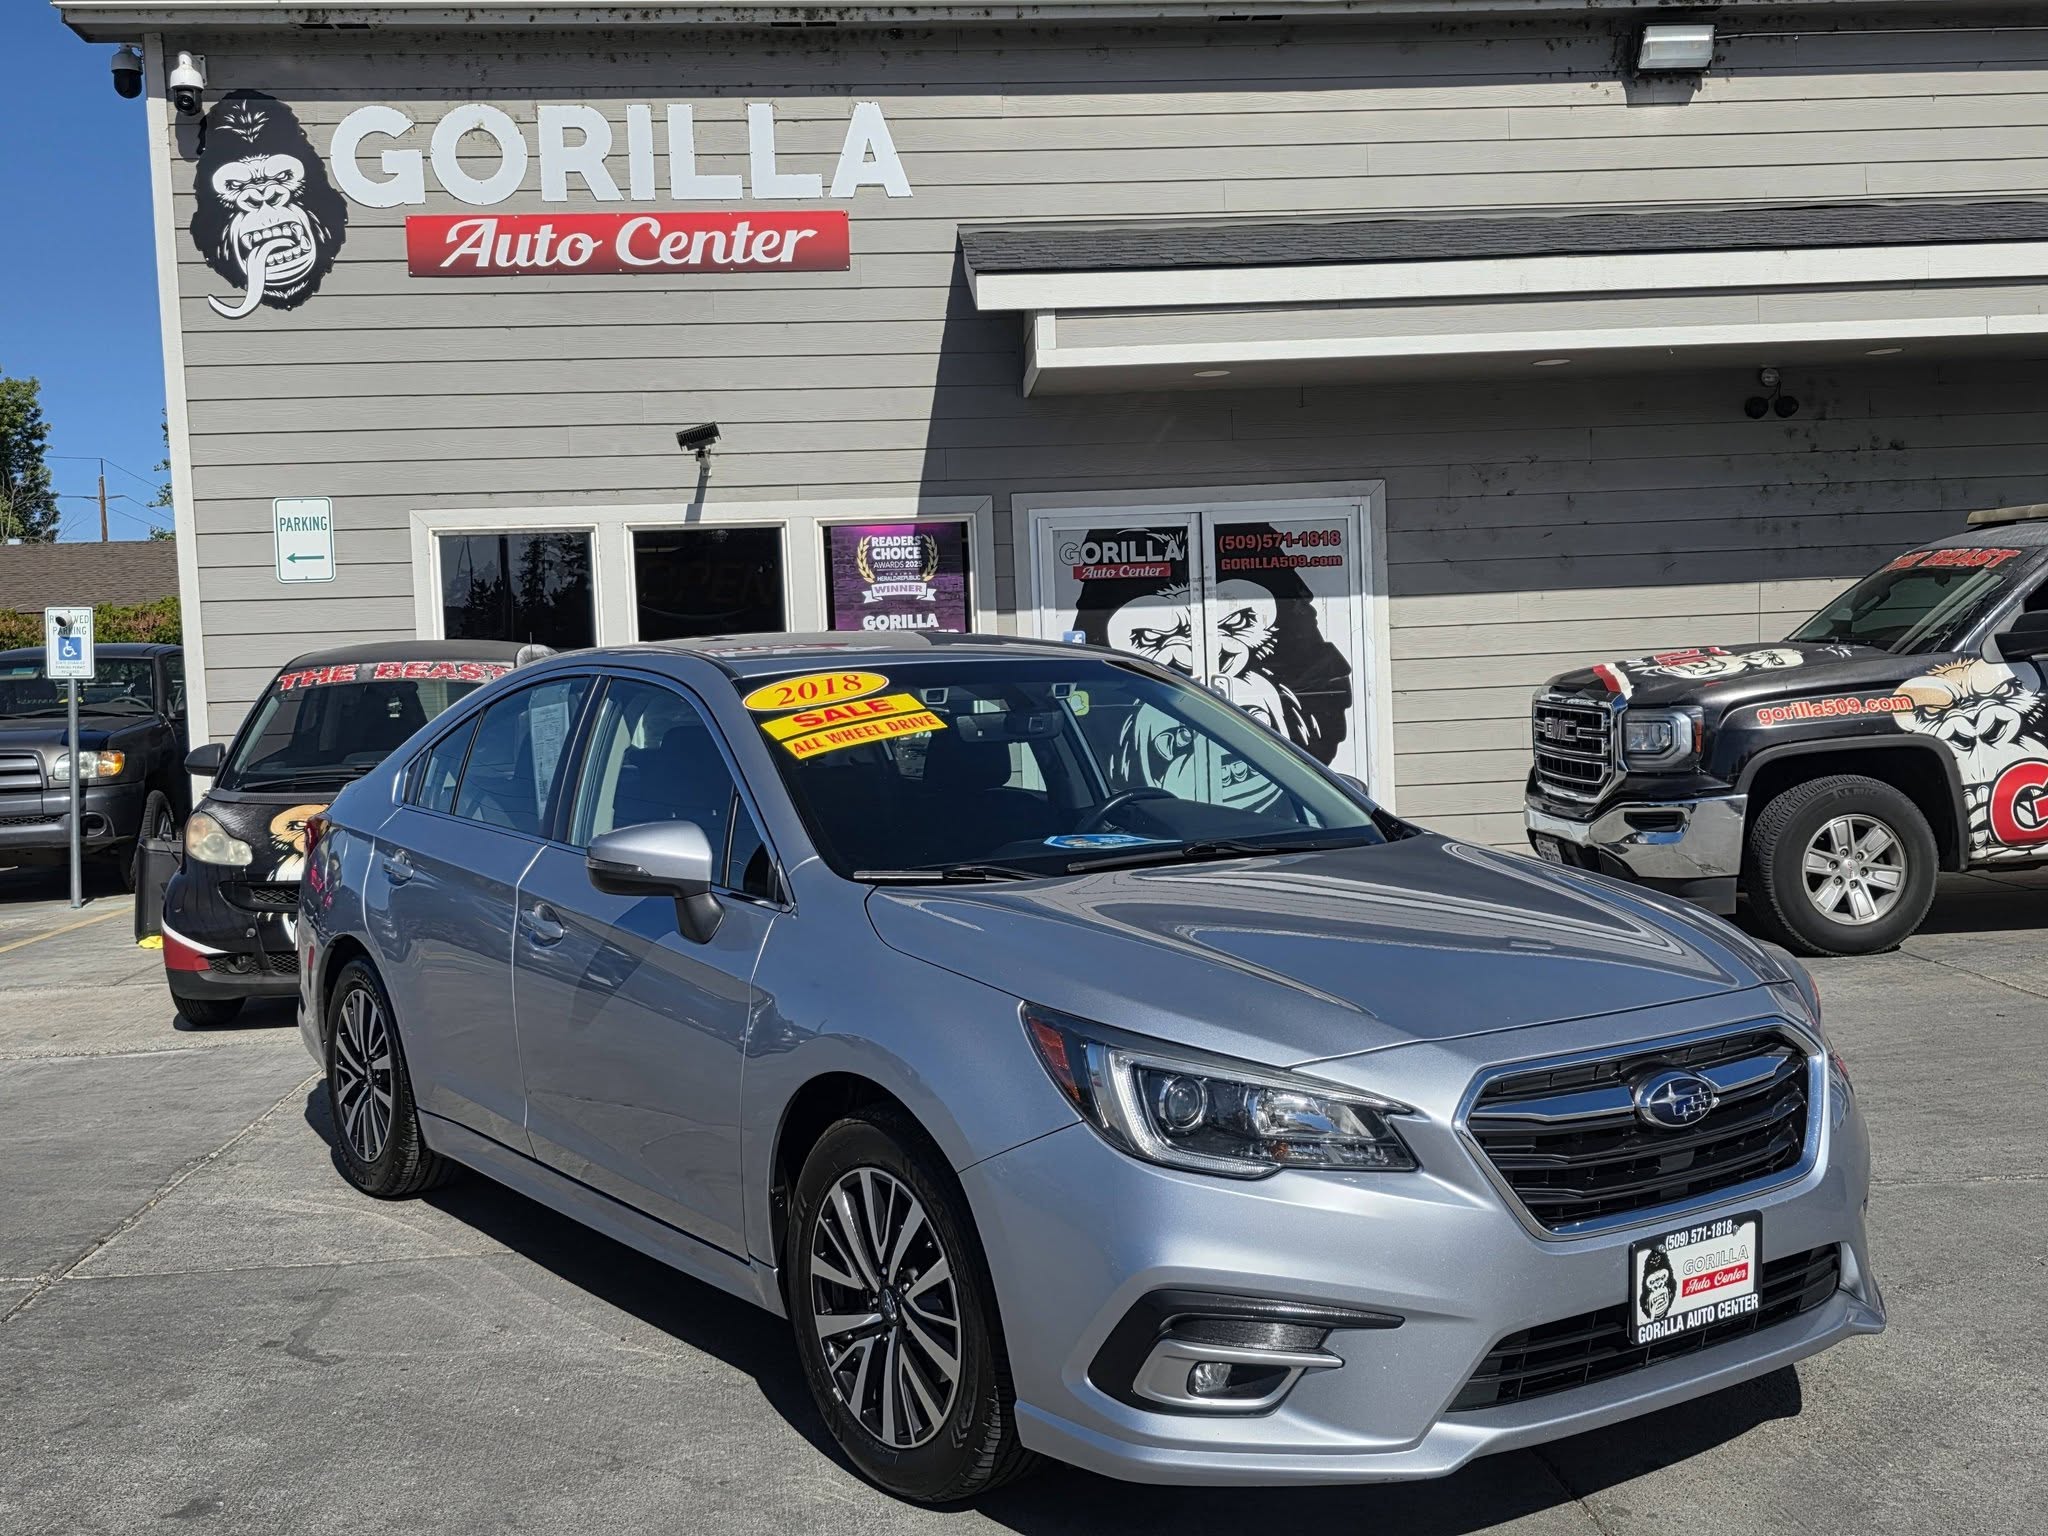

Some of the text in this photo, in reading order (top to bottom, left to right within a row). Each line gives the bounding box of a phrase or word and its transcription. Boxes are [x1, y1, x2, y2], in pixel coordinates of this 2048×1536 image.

[330, 101, 913, 208] GORILLA
[440, 216, 818, 267] Auto Center
[279, 516, 328, 532] PARKING
[871, 535, 923, 547] READERS'
[872, 547, 922, 561] CHOICE
[1059, 539, 1184, 566] GORILLA
[1218, 530, 1341, 553] (509)571-1818
[873, 560, 904, 569] AWARDS
[1081, 563, 1165, 580] Auto Center
[1220, 555, 1343, 571] GORILLA509.com
[874, 584, 923, 594] WINNER
[862, 613, 940, 631] GORILLA
[277, 661, 513, 691] THE BEAST
[774, 674, 862, 706] 2018
[792, 699, 895, 728] SALE
[1756, 695, 1914, 726] gorilla509.com
[793, 715, 936, 755] ALL WHEEL DRIVE
[1544, 717, 1577, 741] GMC
[1665, 1219, 1733, 1251] (509) 571-1818
[1682, 1244, 1749, 1276] GORILLA
[1684, 1267, 1748, 1295] Auto Center
[1638, 1293, 1759, 1344] GORILLA AUTO CENTER
